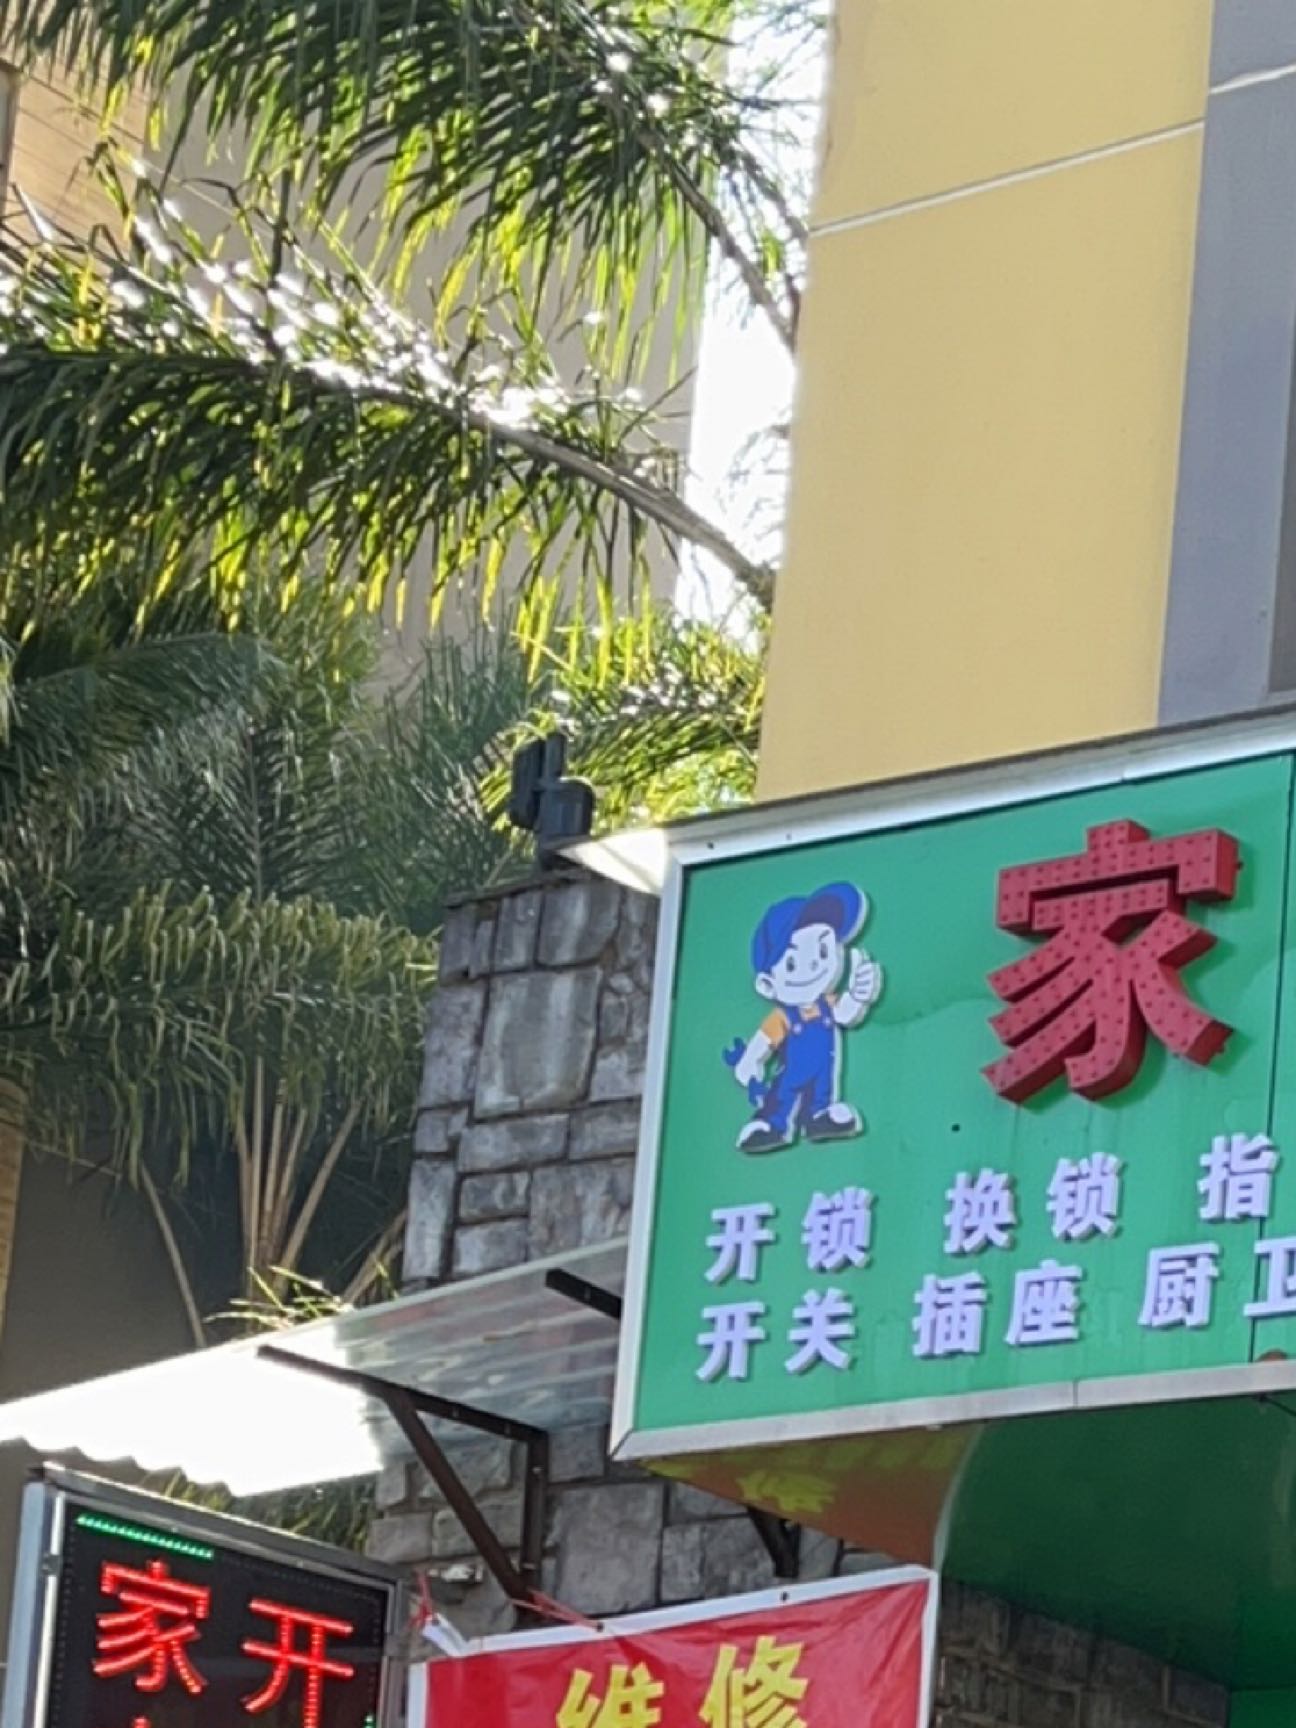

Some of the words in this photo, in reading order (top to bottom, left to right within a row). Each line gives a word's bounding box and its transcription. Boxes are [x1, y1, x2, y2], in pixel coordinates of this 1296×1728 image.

[706, 1187, 874, 1283] 开锁
[944, 1152, 1121, 1253] 换锁
[697, 1288, 856, 1382] 开关
[912, 1259, 1083, 1358] 插座
